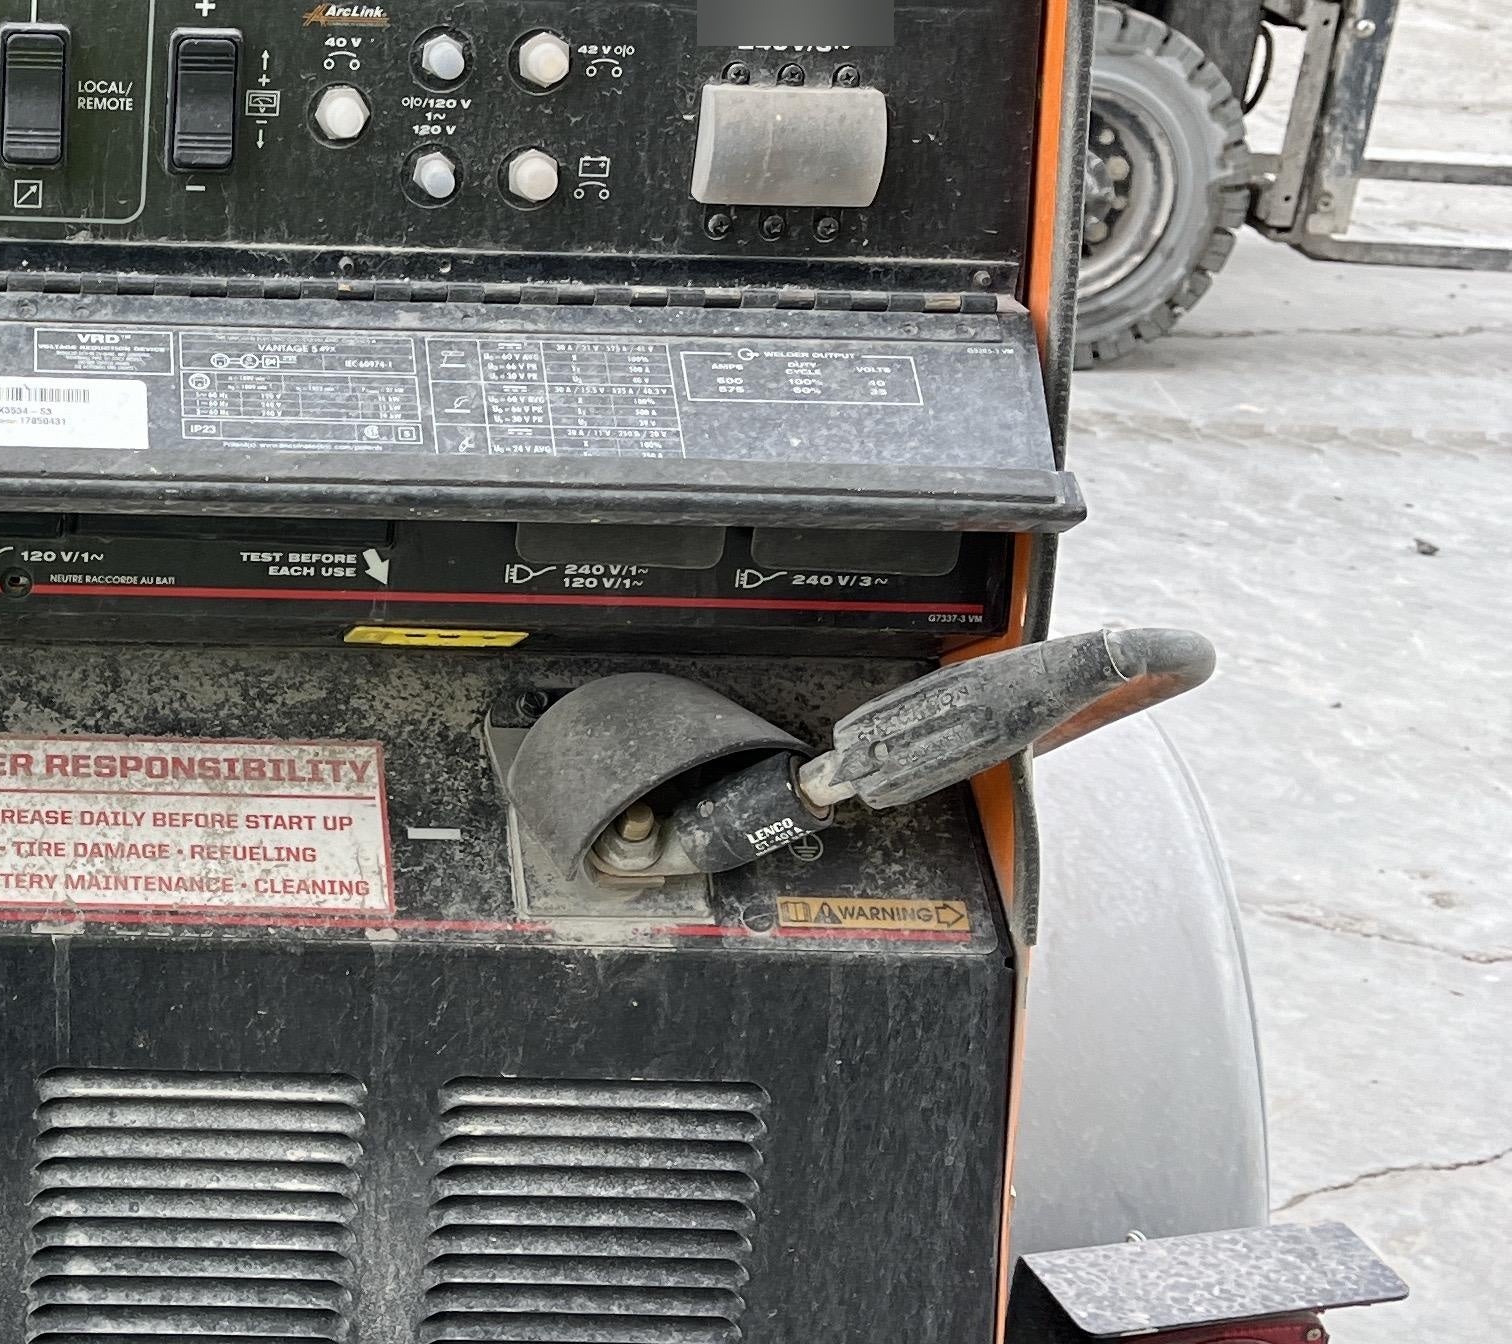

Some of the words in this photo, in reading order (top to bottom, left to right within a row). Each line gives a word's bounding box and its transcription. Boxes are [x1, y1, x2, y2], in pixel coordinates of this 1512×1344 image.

[325, 37, 347, 48] 40
[348, 38, 362, 48] V
[78, 80, 133, 96] LOCAL/
[78, 97, 134, 111] REMOTE
[413, 125, 442, 135] 120
[258, 343, 308, 353] VANTAGE
[190, 424, 216, 433] IP23
[21, 550, 56, 562] 120
[240, 552, 283, 563] TEST
[288, 553, 357, 564] BEFORE
[268, 565, 315, 576] EACH
[321, 566, 357, 577] USE
[564, 564, 605, 575] 240
[50, 573, 83, 583] NEUTRE
[140, 575, 154, 584] AU
[563, 577, 598, 588] 120
[792, 574, 834, 586] 240
[927, 614, 966, 623] G7337-3
[968, 615, 983, 623] VM
[45, 753, 371, 783] RESPONSIBILITY
[80, 810, 146, 827] DAILY
[152, 812, 238, 829] BEFORE
[245, 814, 316, 831] START
[323, 816, 353, 831] UP
[745, 818, 794, 844] LENCO
[13, 841, 66, 858] TIRE
[74, 842, 170, 860] DAMAGE
[190, 844, 317, 863] REFUELING
[64, 874, 234, 894] MAINTENANCE
[254, 878, 370, 897] CLEANING
[838, 905, 934, 922] WARNING
